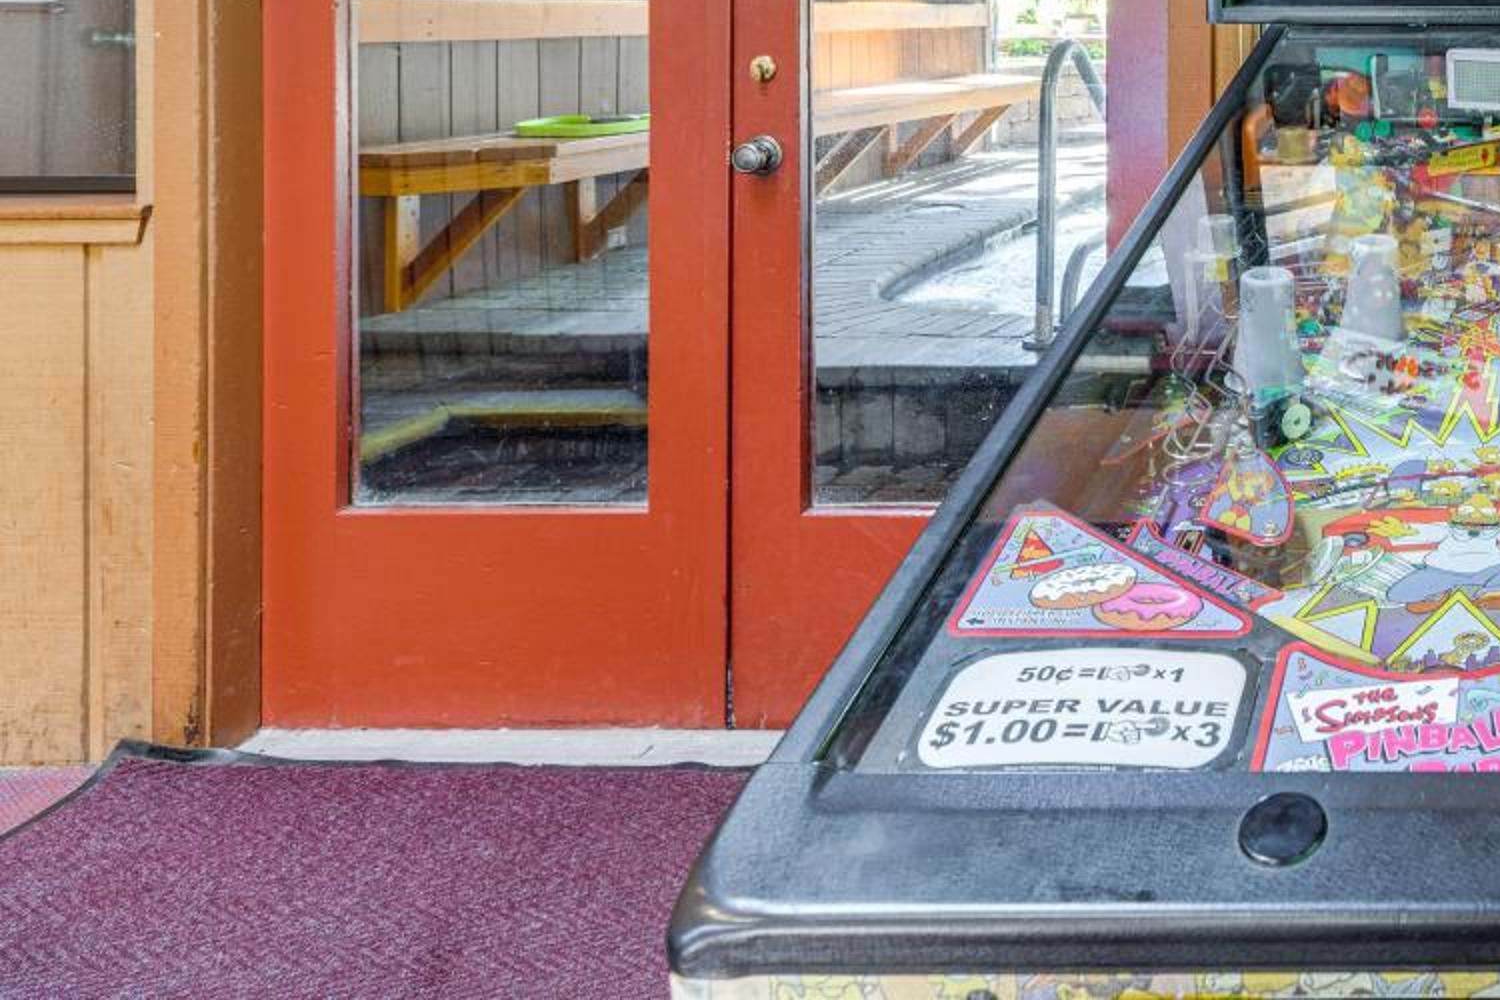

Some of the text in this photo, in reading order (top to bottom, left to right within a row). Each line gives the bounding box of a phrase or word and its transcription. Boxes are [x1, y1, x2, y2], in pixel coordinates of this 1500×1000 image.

[1352, 687, 1399, 705] THE
[943, 698, 1230, 718] SUPER VALUE
[1314, 699, 1439, 733] SIMPSONS
